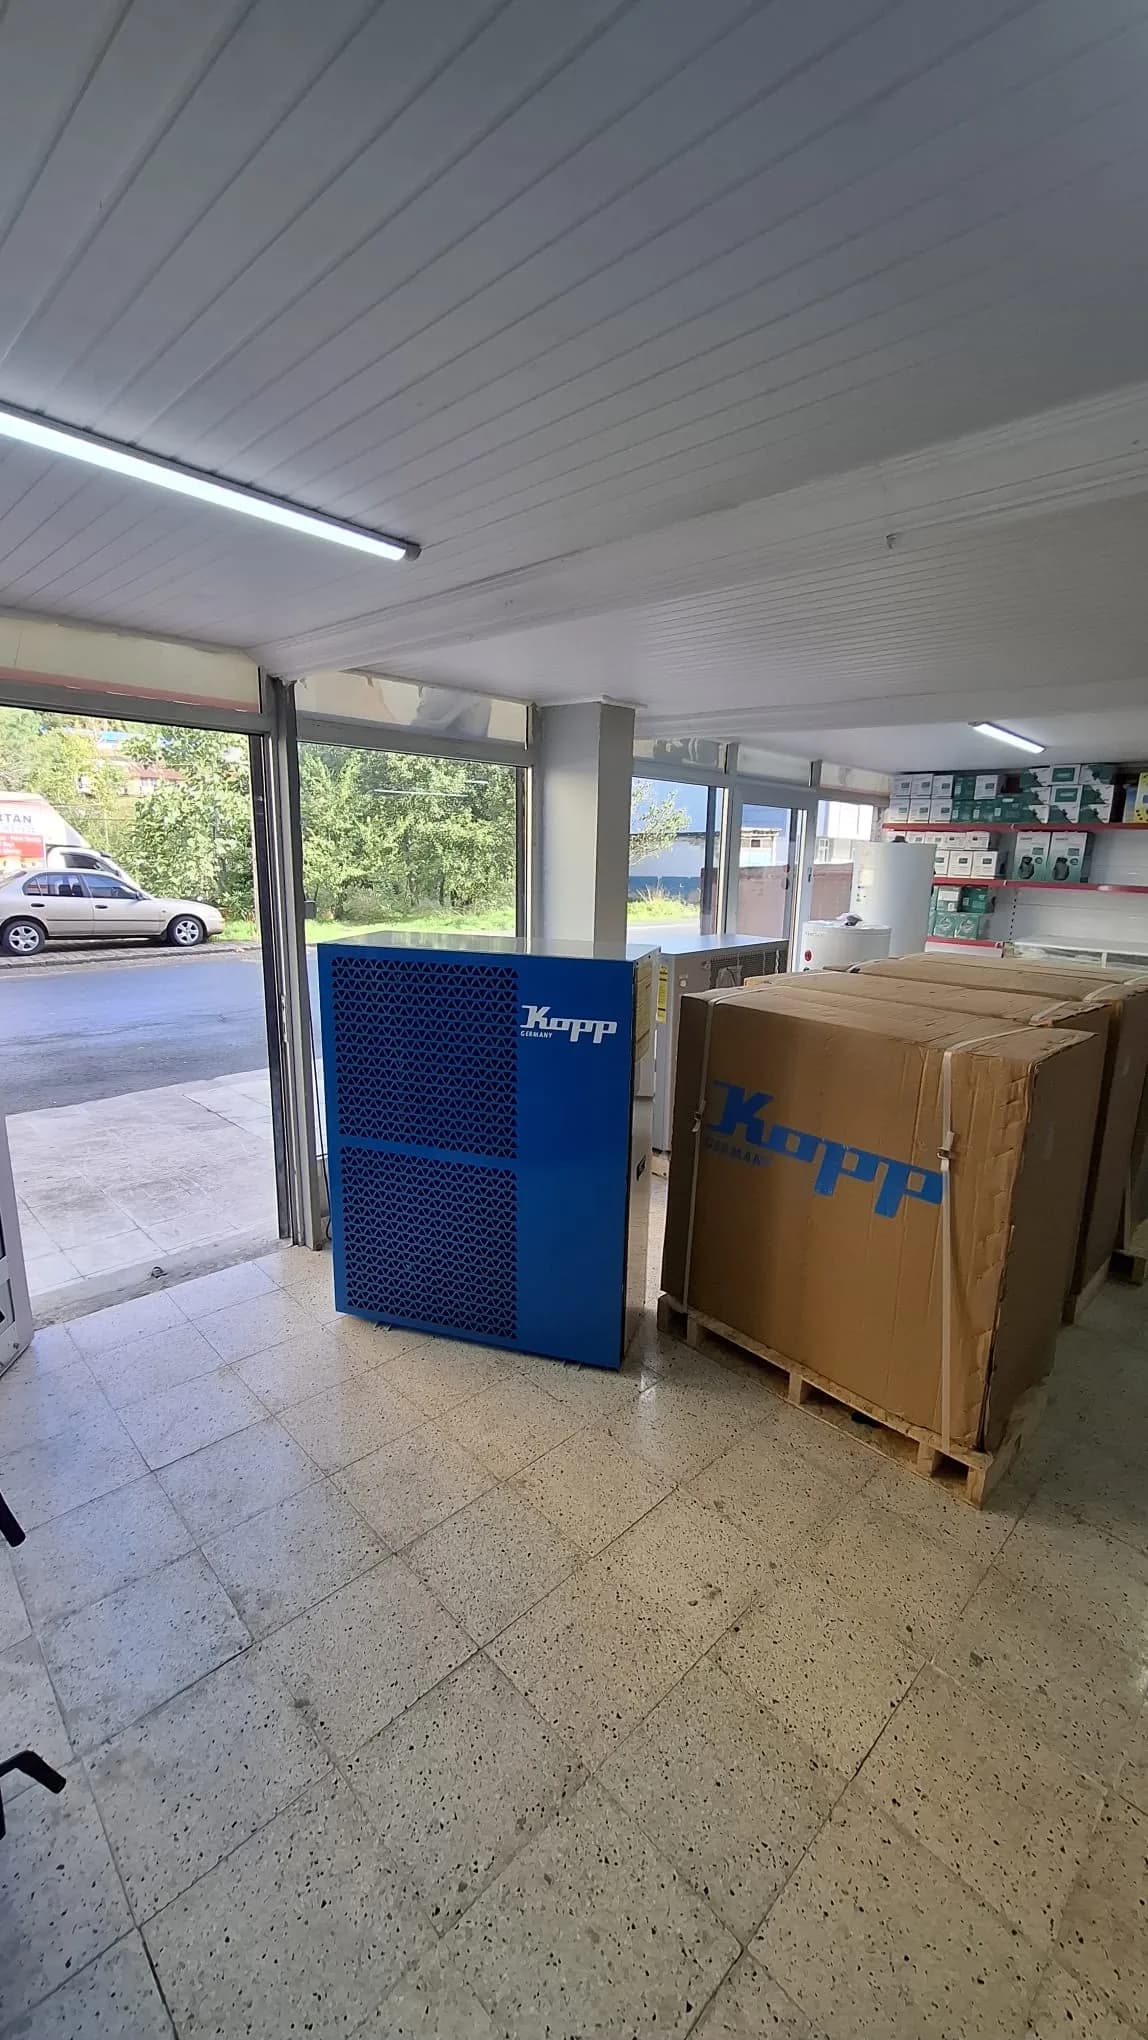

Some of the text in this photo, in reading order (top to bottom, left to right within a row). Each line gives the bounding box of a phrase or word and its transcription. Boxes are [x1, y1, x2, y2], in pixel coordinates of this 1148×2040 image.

[520, 1005, 617, 1044] Kopp
[520, 1030, 553, 1039] GERMANY
[706, 1080, 943, 1219] Kopp
